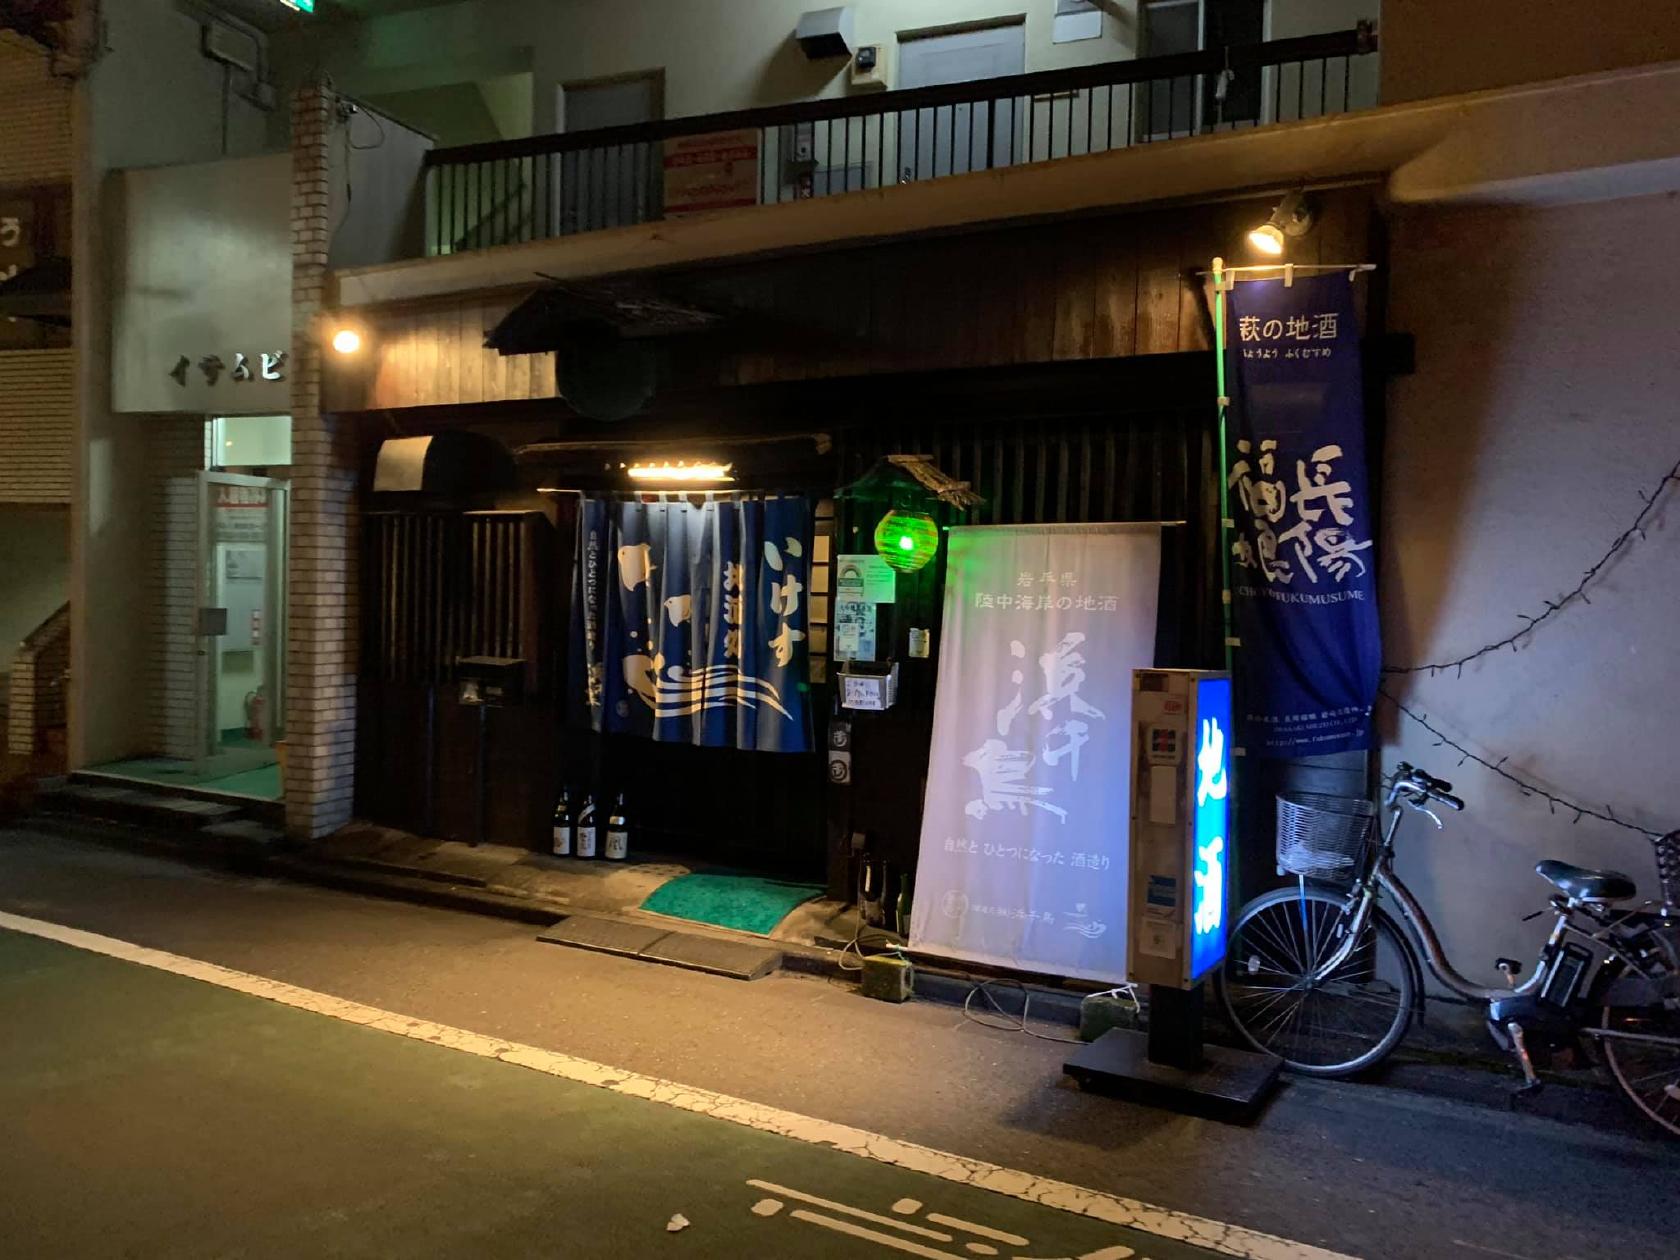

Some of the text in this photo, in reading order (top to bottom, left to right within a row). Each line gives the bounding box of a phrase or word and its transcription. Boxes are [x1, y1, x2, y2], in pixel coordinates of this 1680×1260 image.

[1239, 312, 1340, 342] 萩の地酒
[974, 591, 1120, 612] 陸中海岸の地酒
[983, 841, 1065, 866] ひとつになった
[1069, 850, 1111, 872] 酒造り
